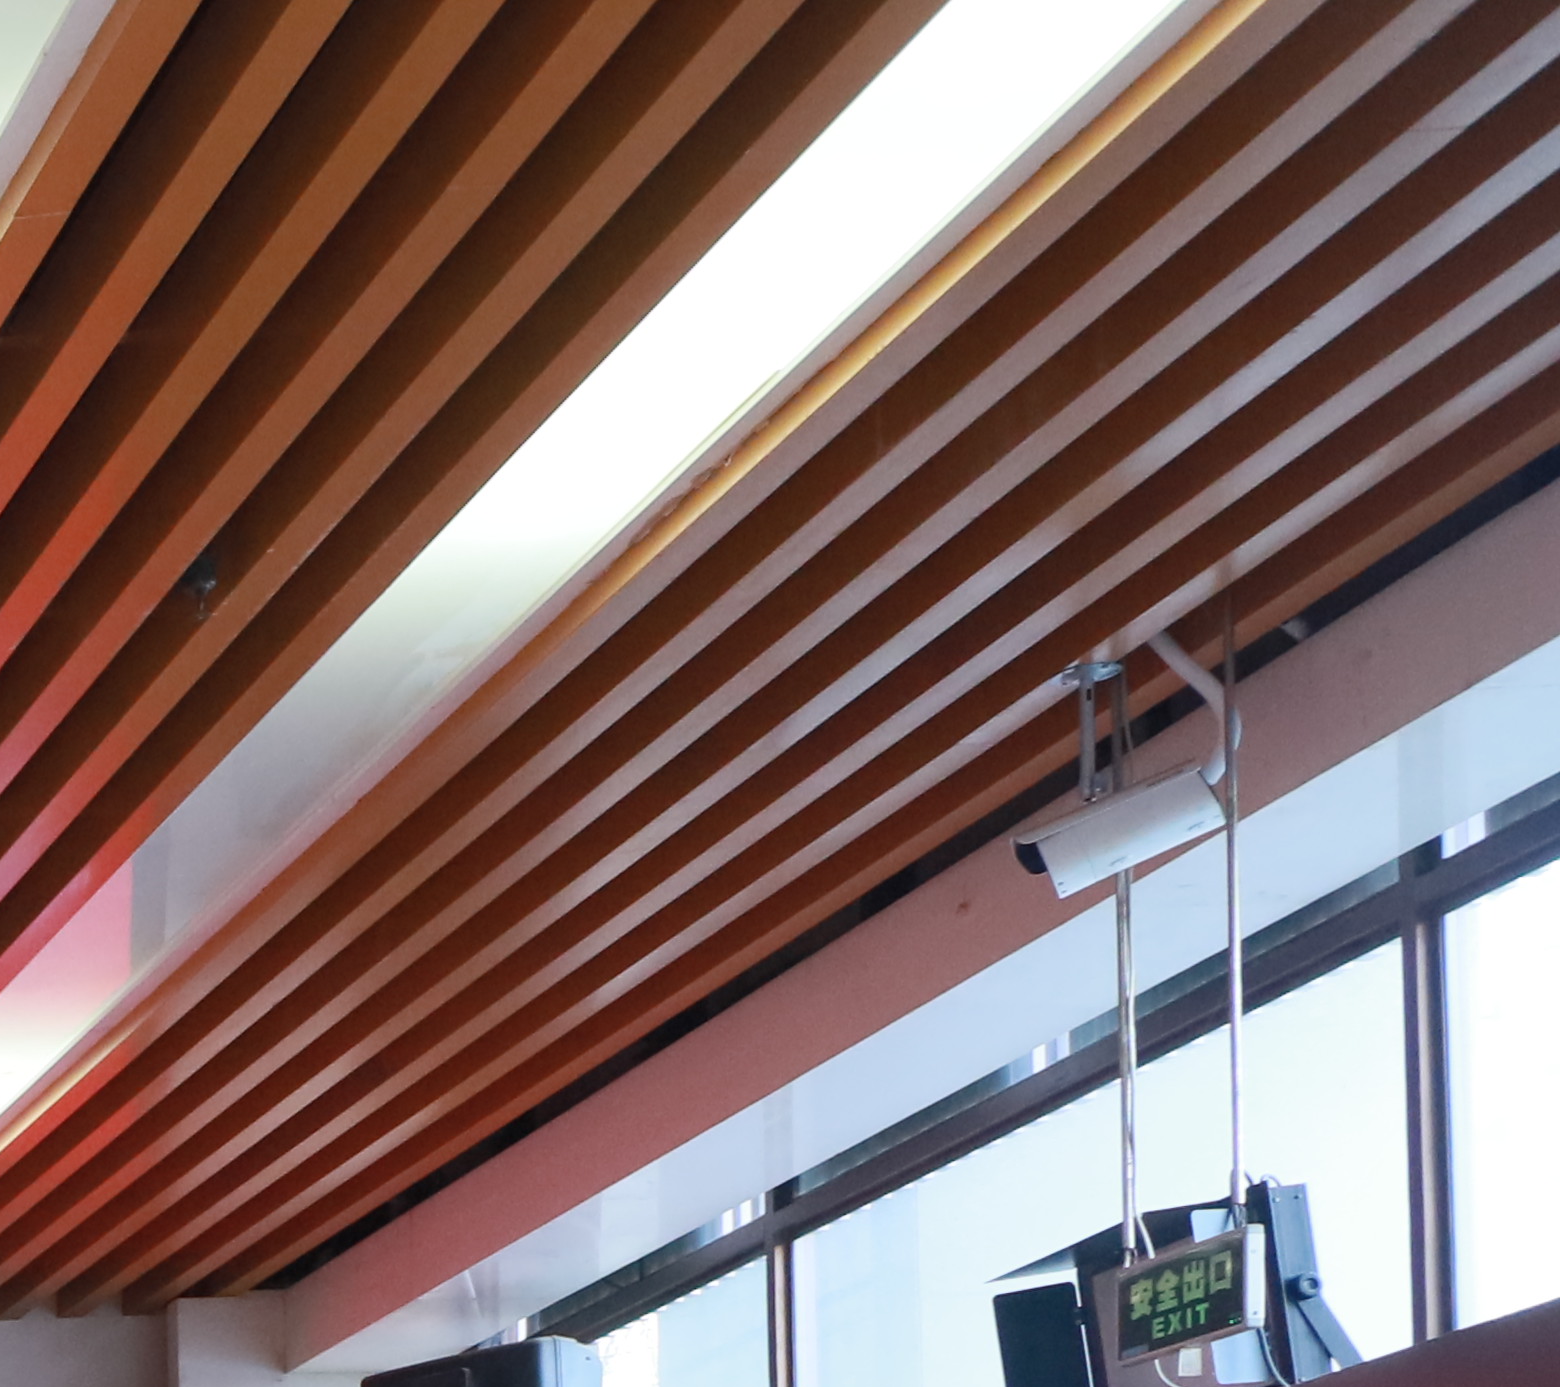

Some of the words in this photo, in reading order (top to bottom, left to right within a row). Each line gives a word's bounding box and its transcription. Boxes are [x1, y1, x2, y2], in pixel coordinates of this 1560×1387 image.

[1130, 1250, 1233, 1320] 安全出口
[1151, 1303, 1210, 1340] EXIT
